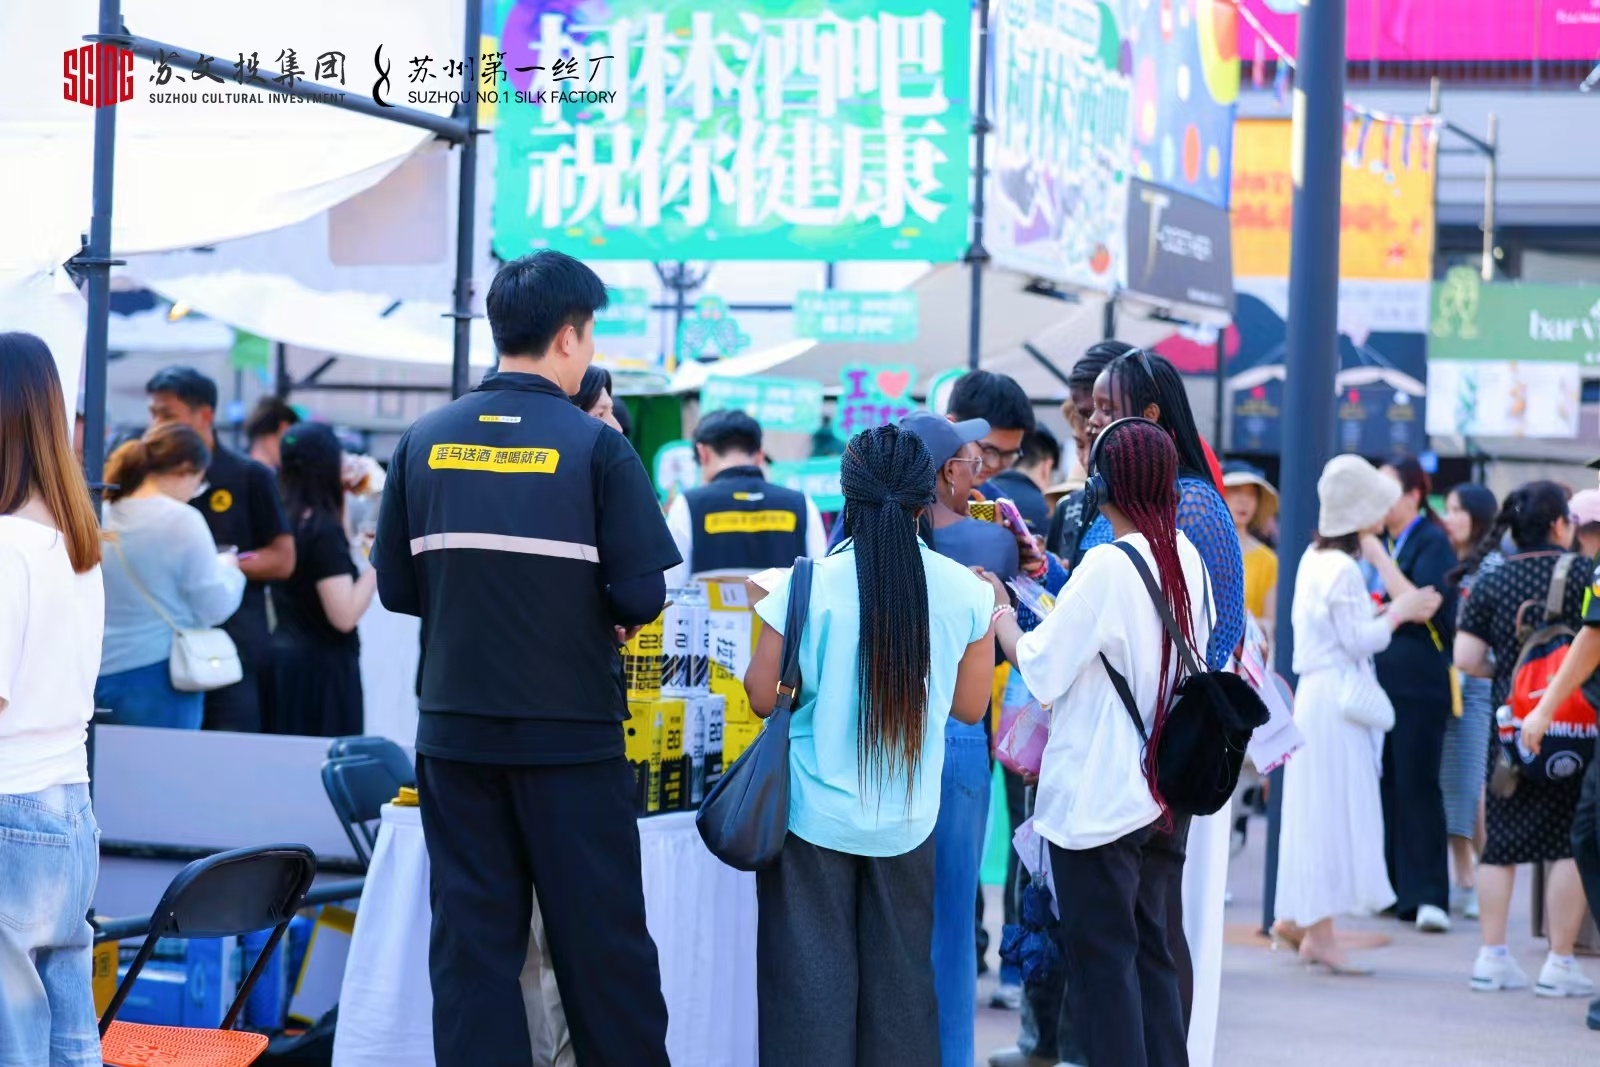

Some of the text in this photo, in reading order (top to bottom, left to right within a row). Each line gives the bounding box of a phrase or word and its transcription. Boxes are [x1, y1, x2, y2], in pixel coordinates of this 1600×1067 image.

[528, 10, 950, 123] 柯林酒吧
[526, 117, 949, 228] 祝你健康
[435, 446, 549, 465] 歪马送酒 想喝就有
